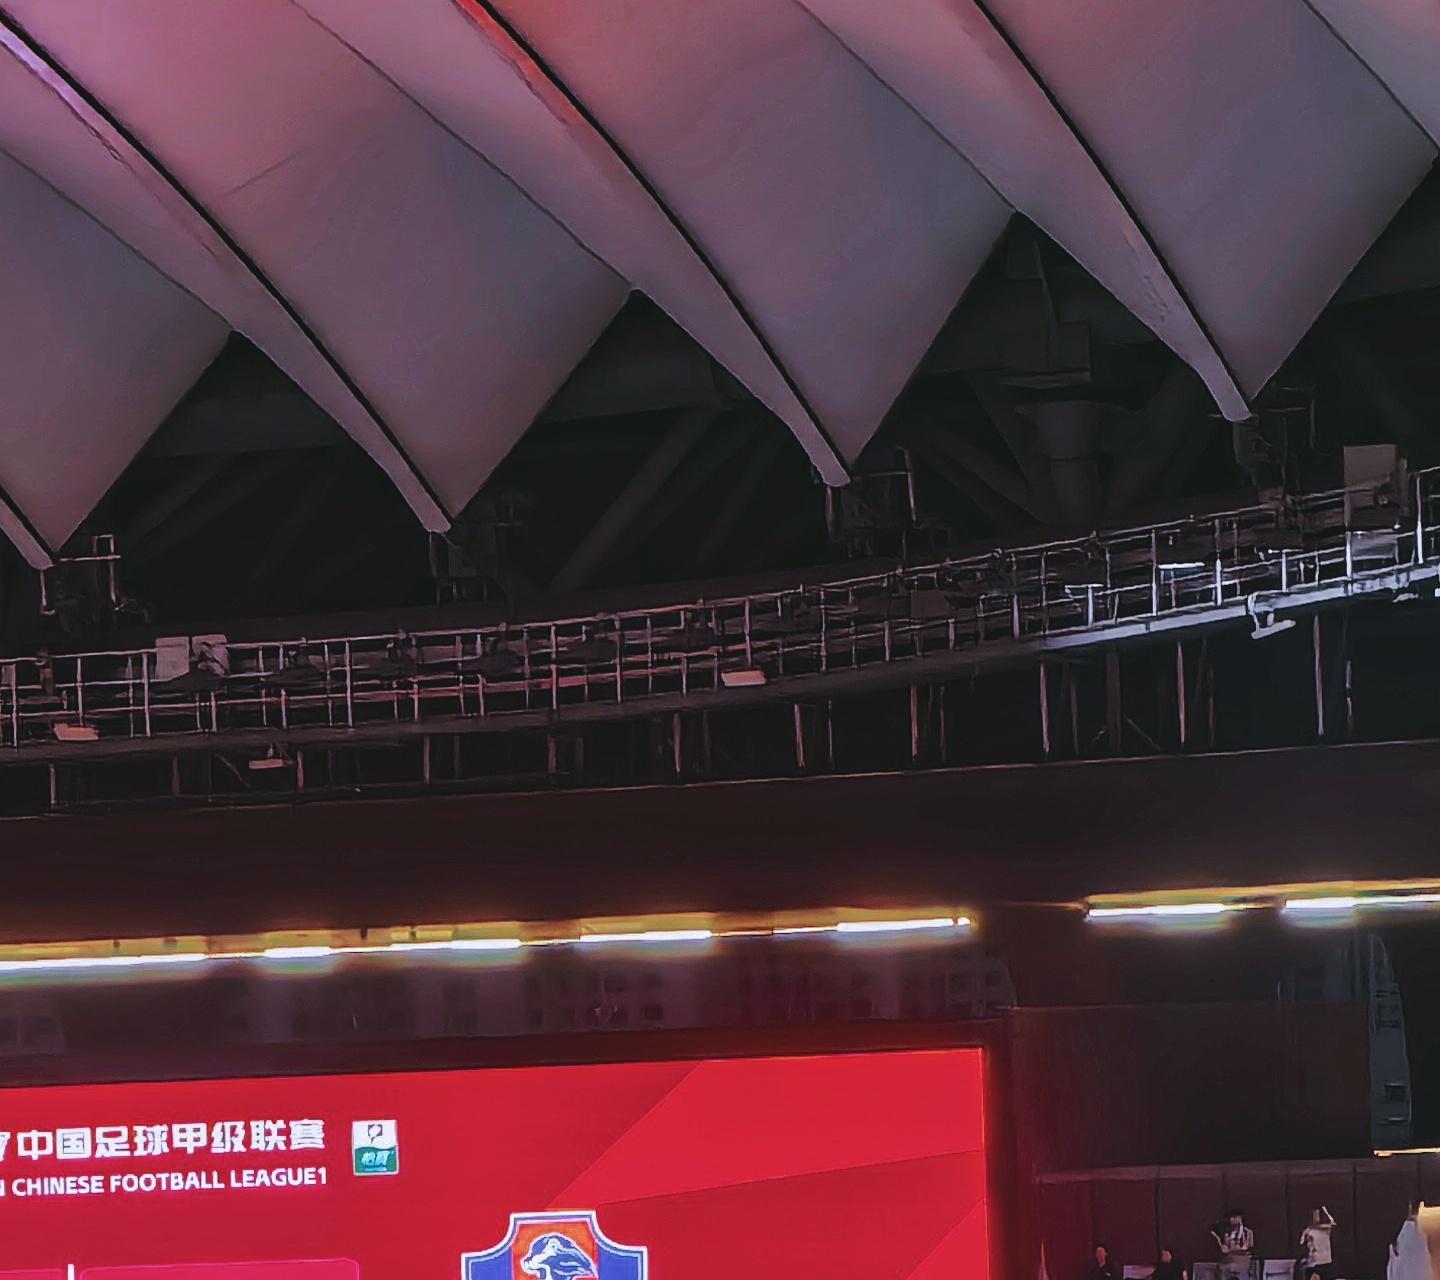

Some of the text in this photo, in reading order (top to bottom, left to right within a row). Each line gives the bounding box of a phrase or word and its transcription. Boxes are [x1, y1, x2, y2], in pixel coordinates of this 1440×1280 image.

[18, 1119, 327, 1161] 中国足球甲级联赛
[11, 1174, 104, 1197] CHINESE
[110, 1170, 225, 1193] FOOTBALL
[230, 1167, 328, 1189] LEAGUE1
